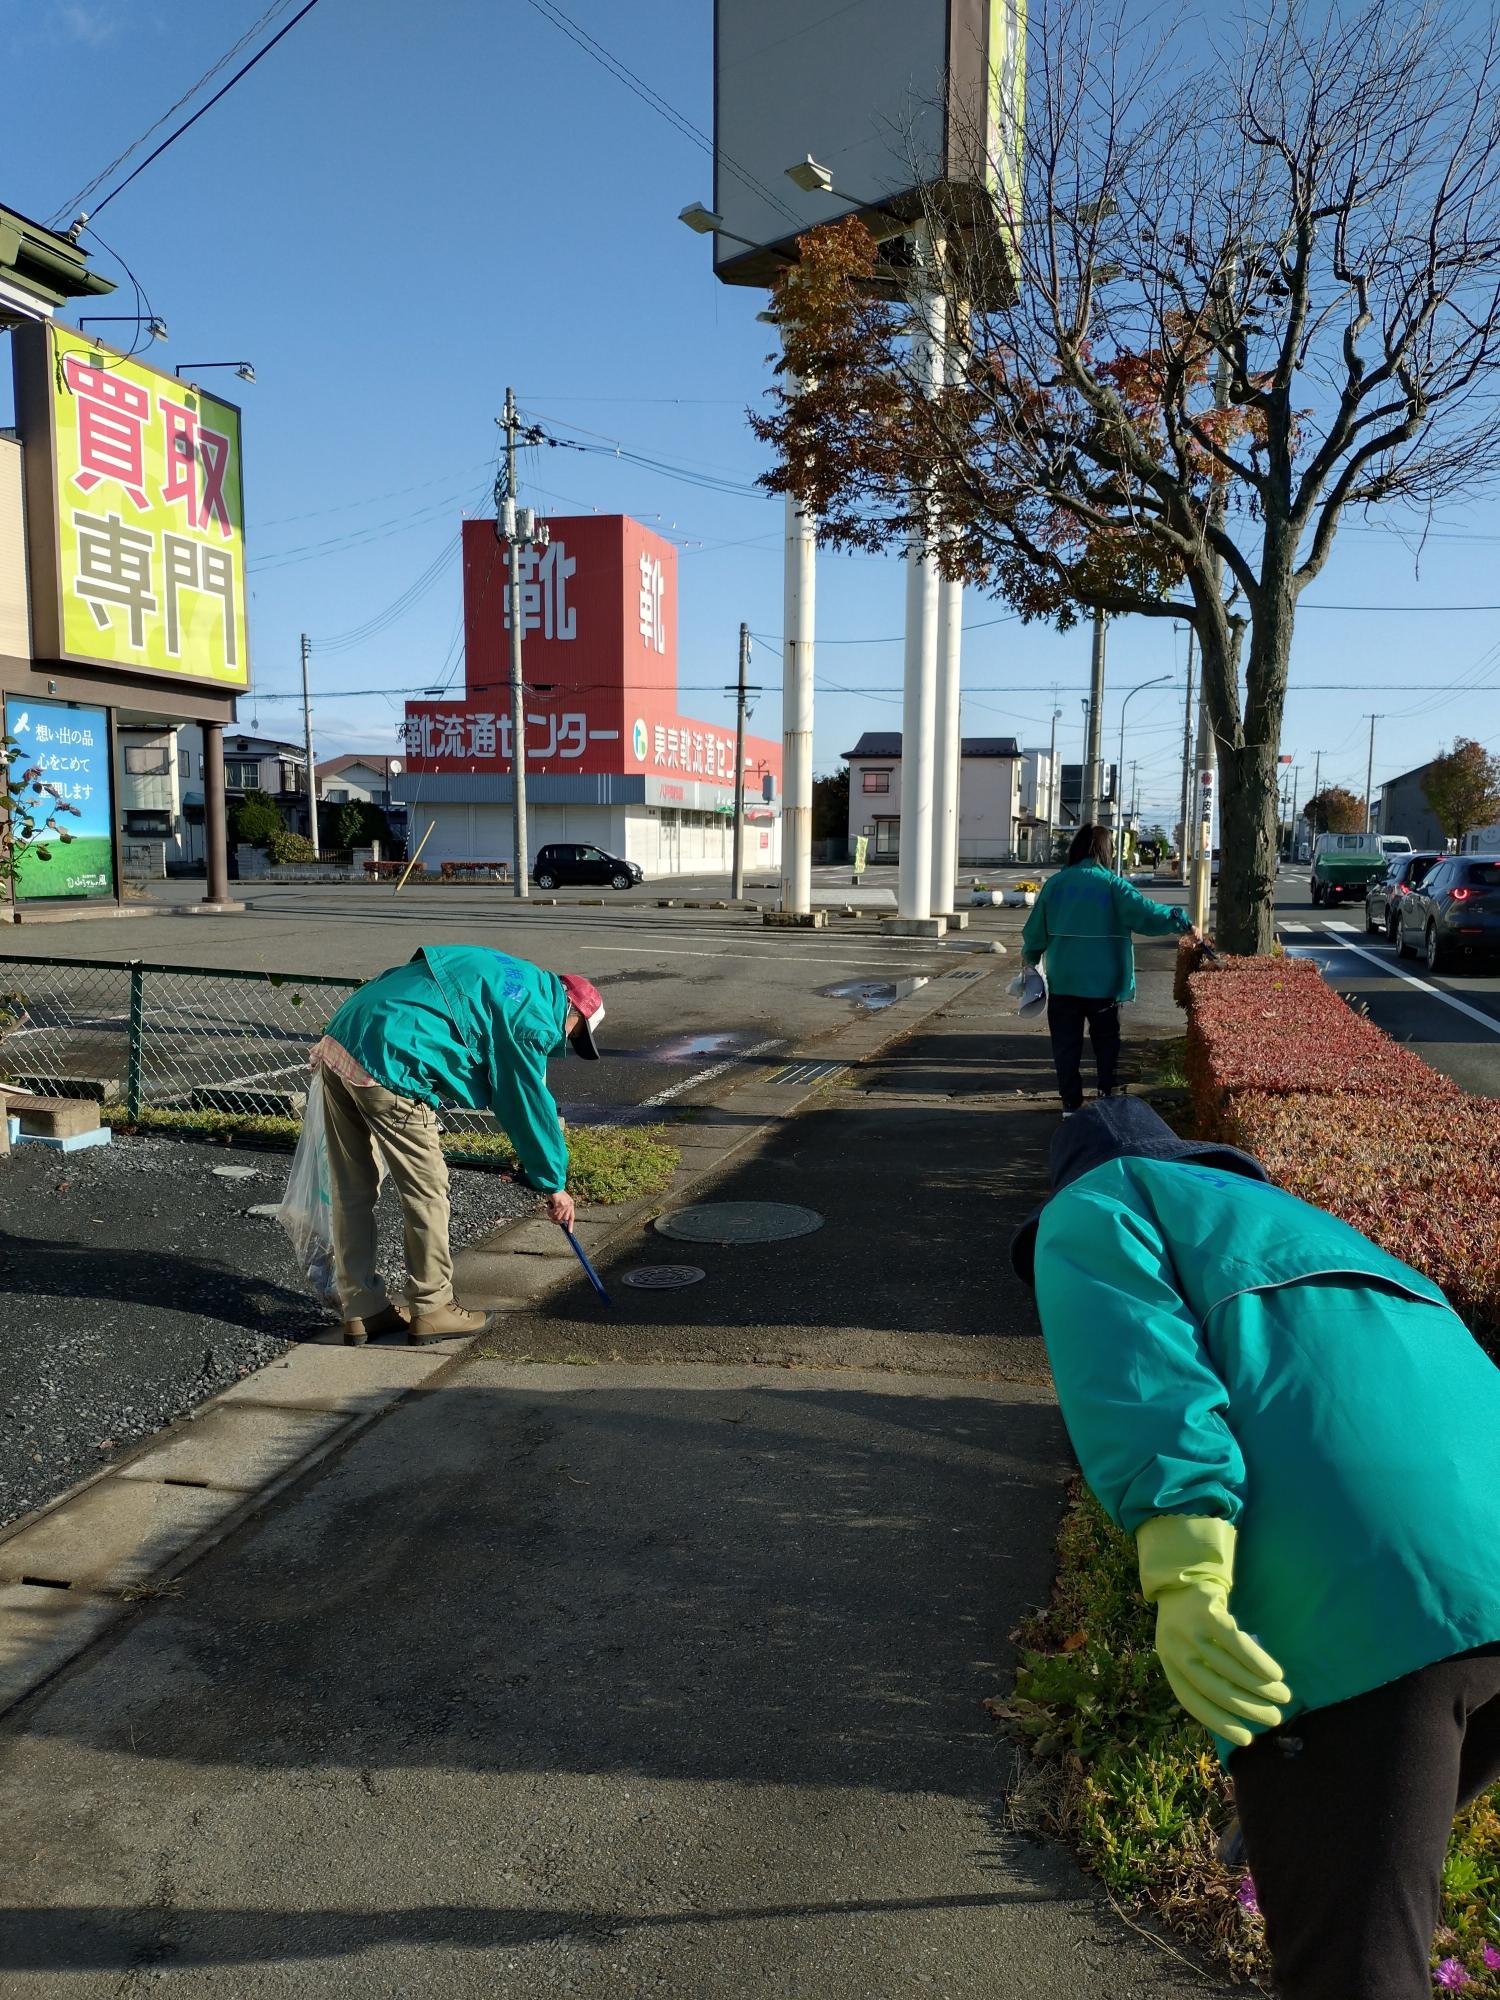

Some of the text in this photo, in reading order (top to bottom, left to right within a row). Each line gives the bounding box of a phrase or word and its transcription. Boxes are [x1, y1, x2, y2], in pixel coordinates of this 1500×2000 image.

[63, 355, 230, 540] 買取
[72, 510, 238, 669] 専門
[502, 540, 577, 641] 靴
[639, 551, 666, 655] 靴
[35, 723, 94, 747] 想い出の品
[37, 752, 91, 773] 心をこめて
[405, 712, 620, 759] 靴流通センター
[654, 722, 753, 779] 東京靴流通センー
